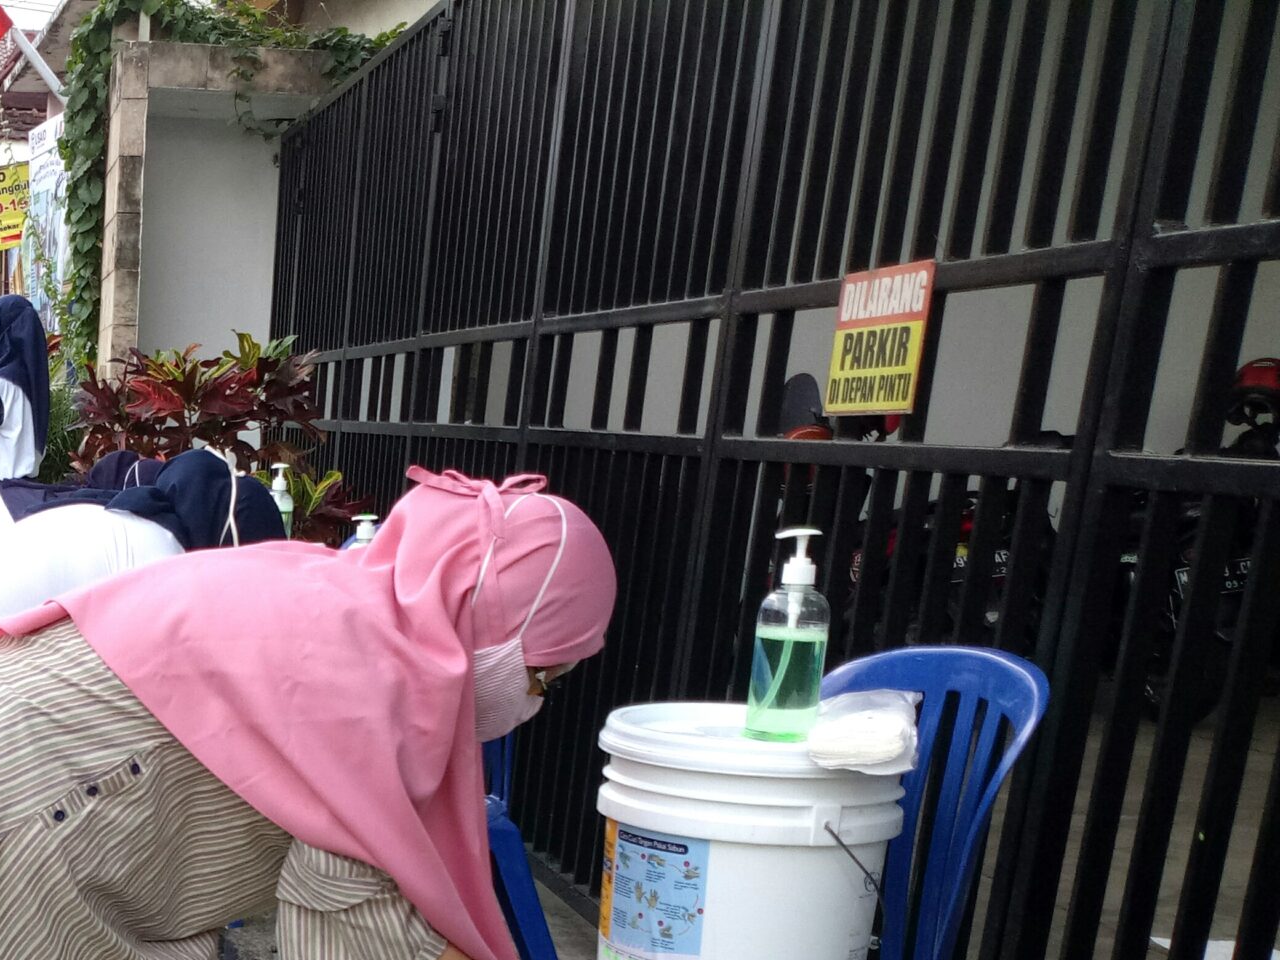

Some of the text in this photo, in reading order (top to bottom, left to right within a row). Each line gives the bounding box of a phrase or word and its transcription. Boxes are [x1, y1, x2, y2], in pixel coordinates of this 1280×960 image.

[841, 271, 927, 321] DILARANG
[840, 326, 911, 371] PARKIR
[828, 373, 912, 404] DI DEPAN PINTU
